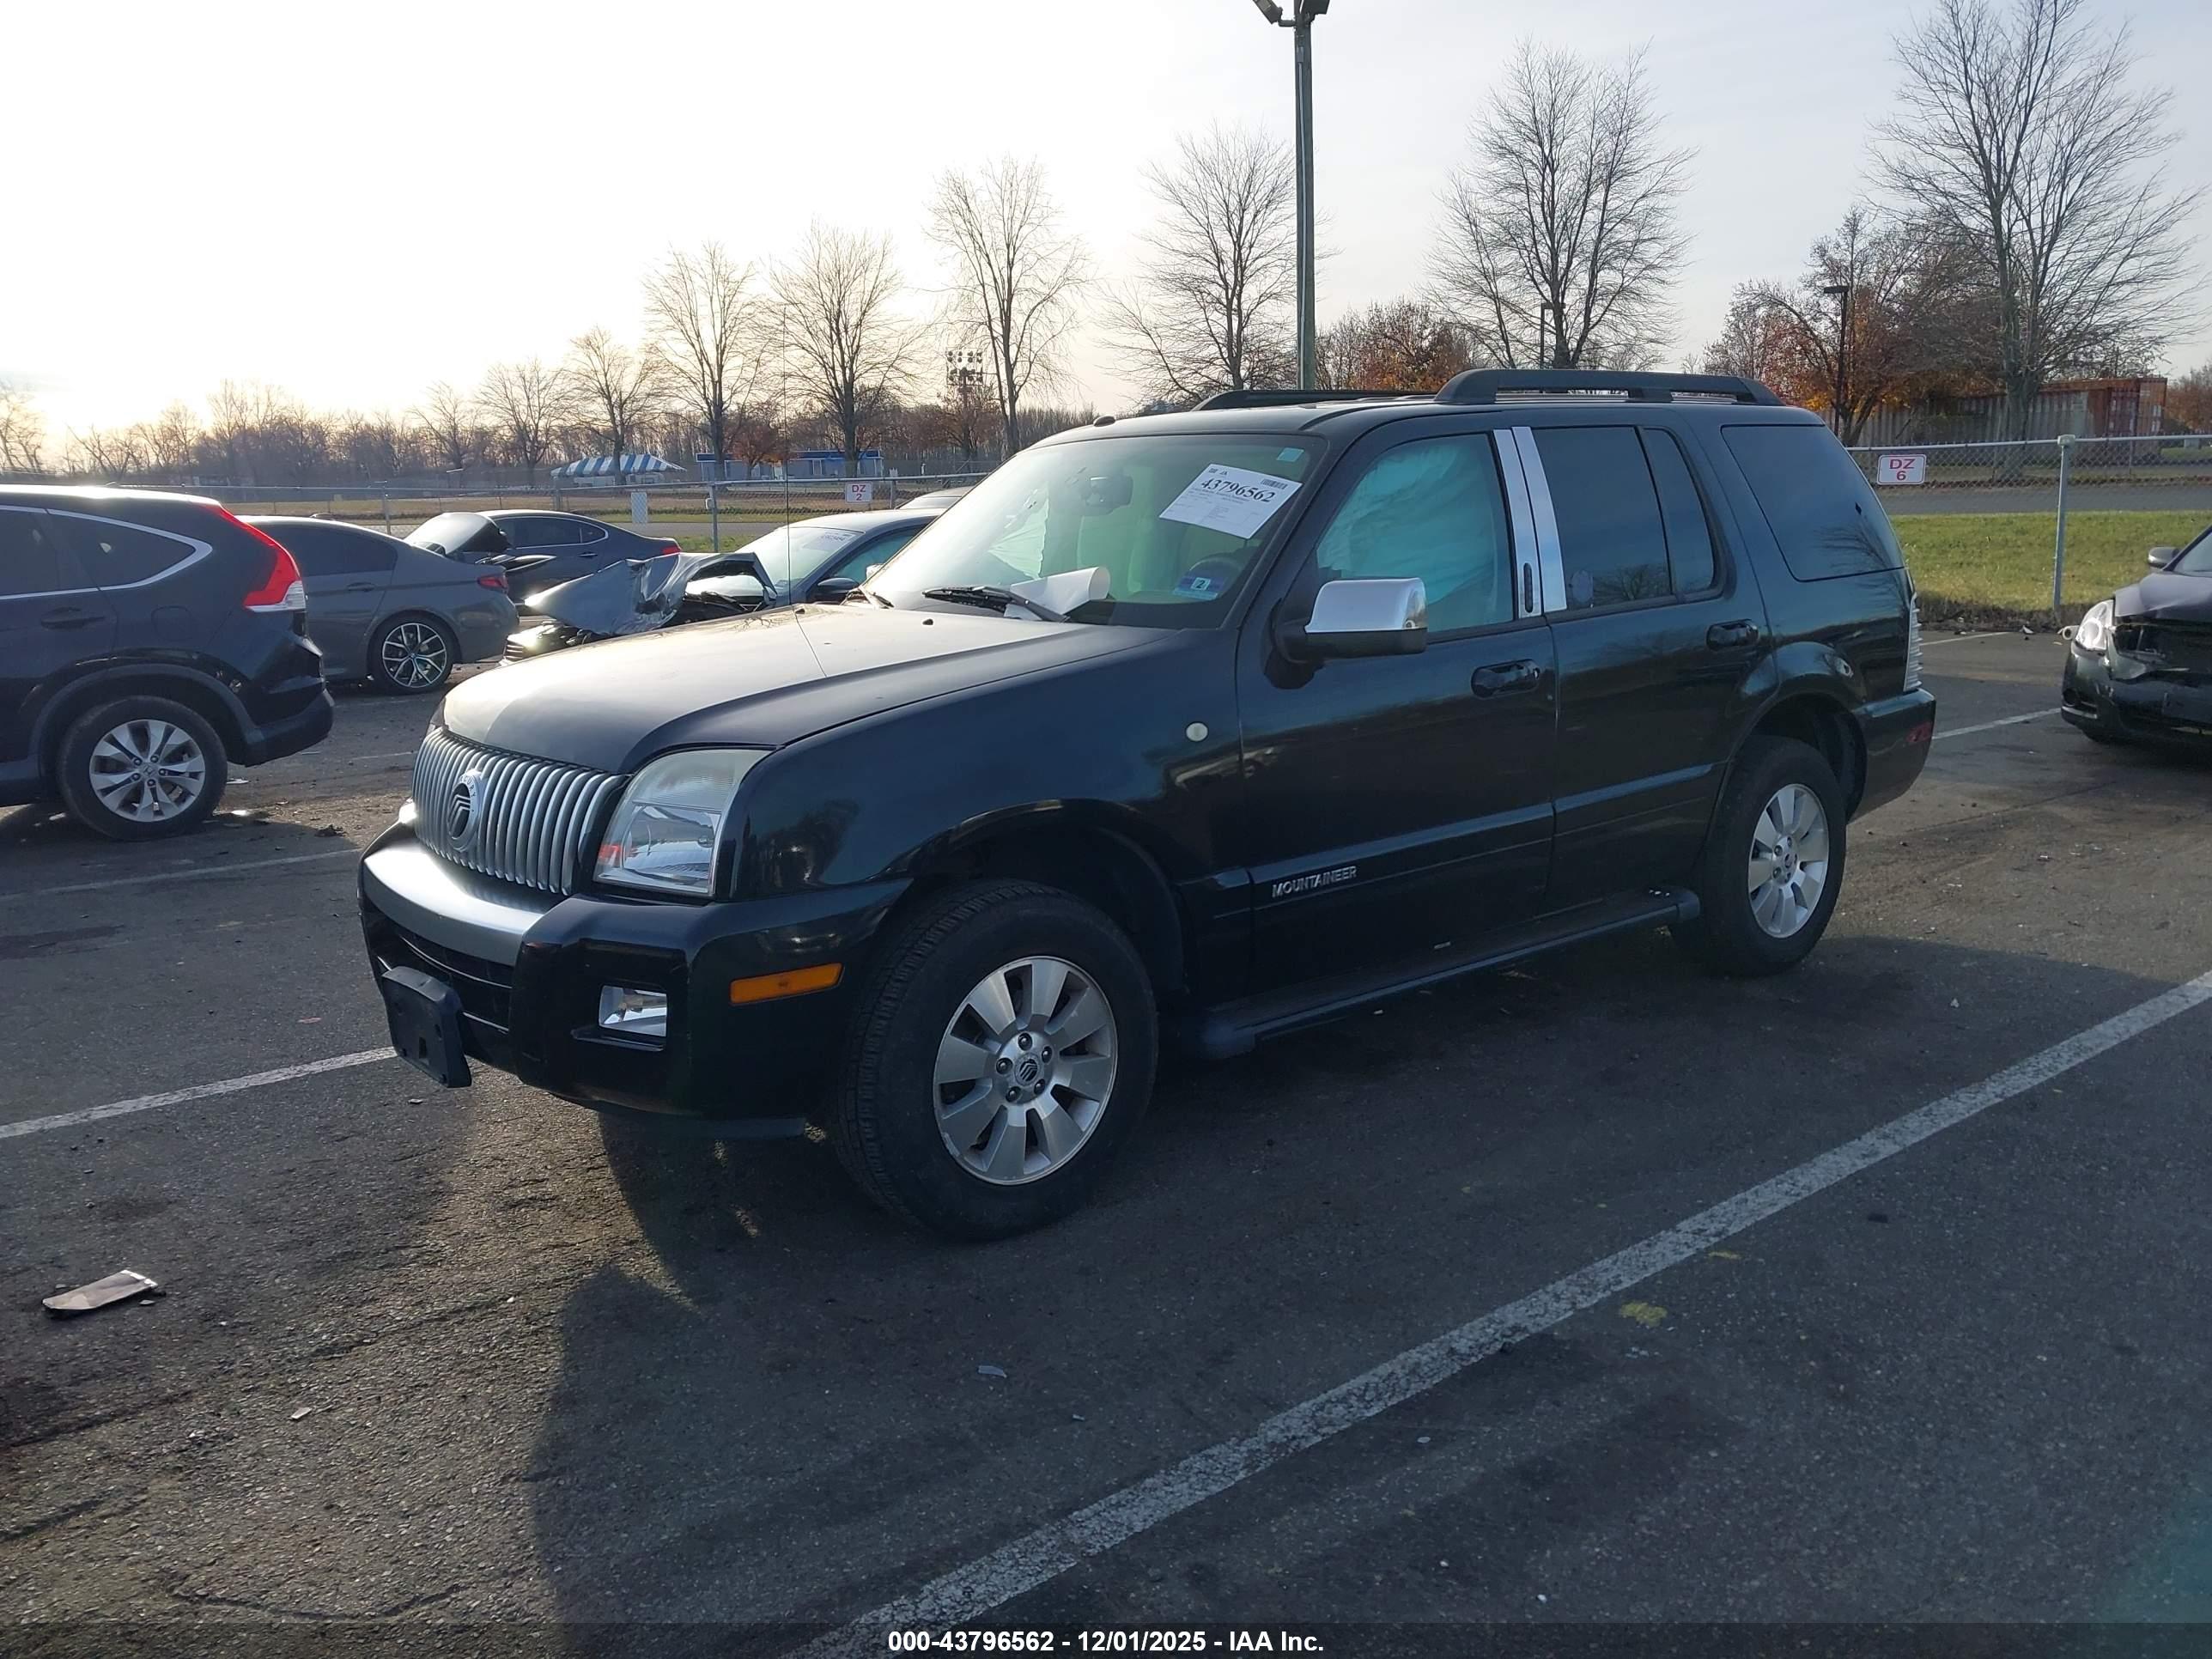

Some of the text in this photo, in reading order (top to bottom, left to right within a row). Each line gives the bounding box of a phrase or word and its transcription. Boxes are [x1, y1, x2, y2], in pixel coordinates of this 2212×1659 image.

[1889, 459, 1916, 469] DZ
[1896, 471, 1906, 481] 6
[852, 484, 866, 493] DZ
[1201, 478, 1275, 502] 43796562
[1196, 580, 1206, 589] 2
[1272, 866, 1357, 897] MOUNTAINEER
